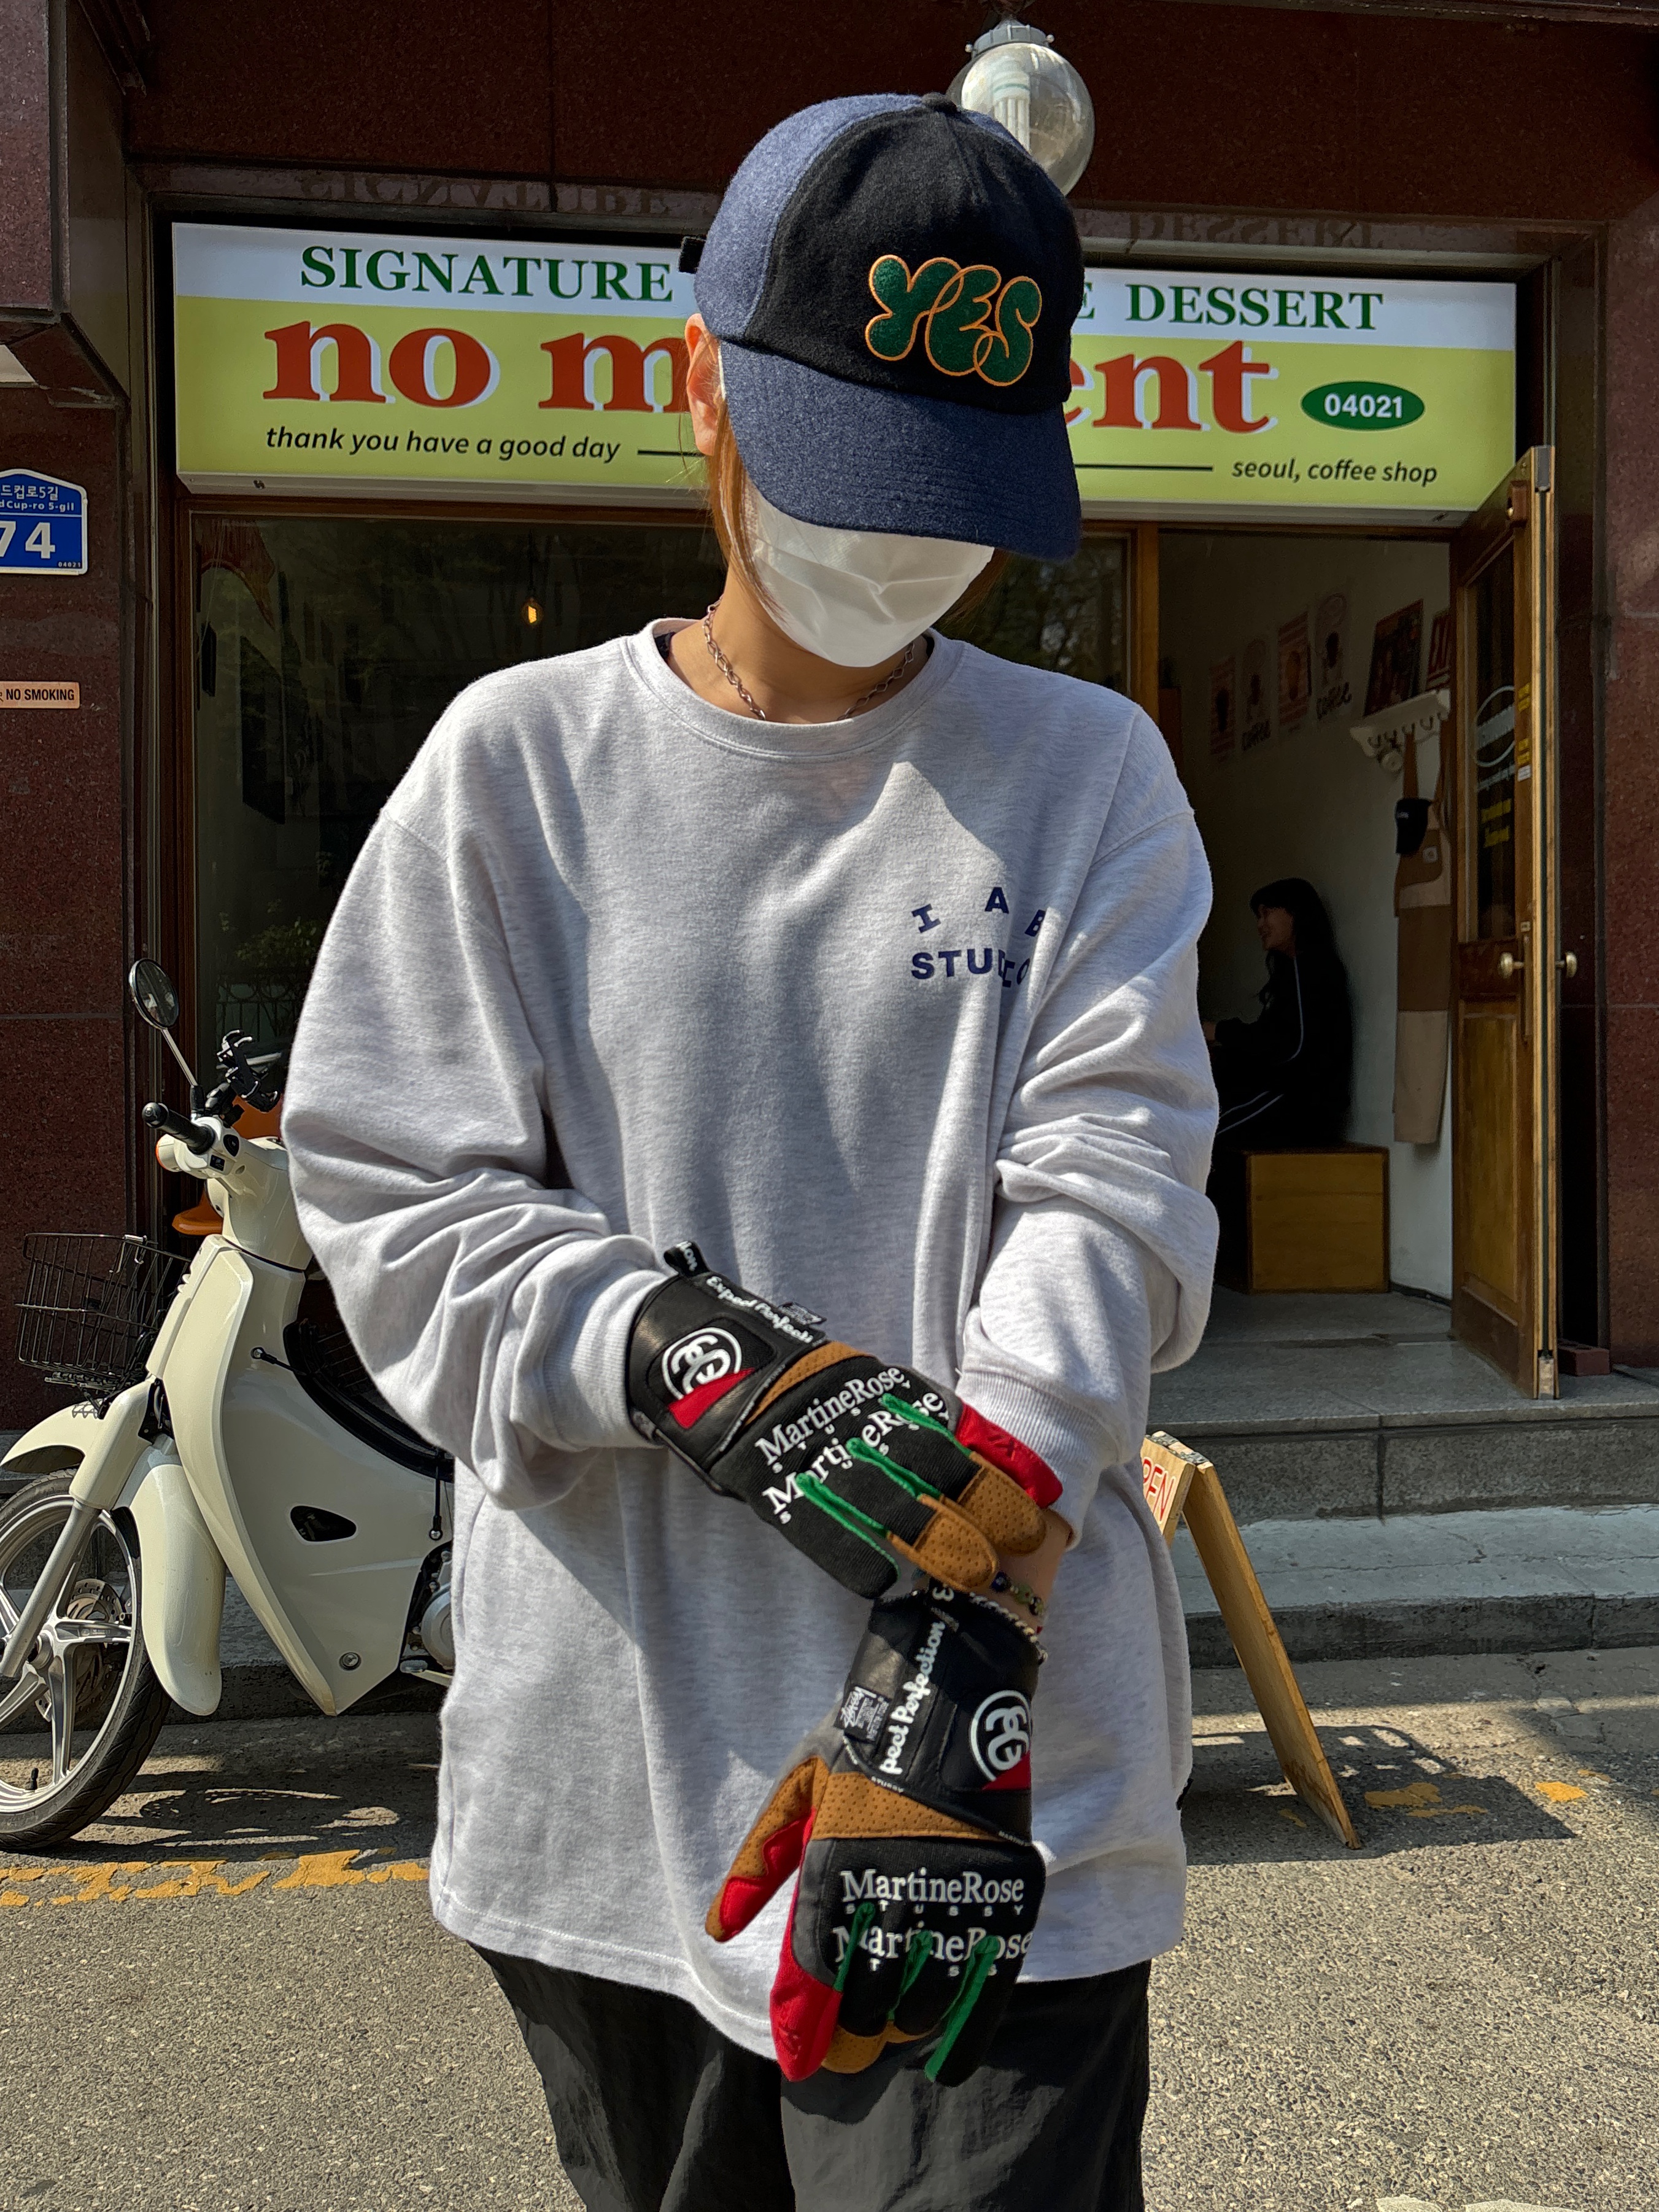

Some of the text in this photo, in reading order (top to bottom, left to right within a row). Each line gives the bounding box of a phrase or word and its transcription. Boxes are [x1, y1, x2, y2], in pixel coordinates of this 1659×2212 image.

[300, 245, 674, 303] SIGNATURE
[865, 254, 1043, 387] YES
[1125, 282, 1383, 330] DESSERT
[263, 320, 498, 410] no
[1324, 393, 1404, 419] 04021
[266, 425, 622, 464] thank you have a good day
[1232, 457, 1438, 487] seoul, coffee shop
[48, 502, 75, 513] 5-gil
[6, 688, 75, 701] NO SMOKING
[754, 1367, 905, 1466] MartineRose
[891, 1621, 946, 1724] Perfection
[840, 1866, 1025, 1903] MartineRose
